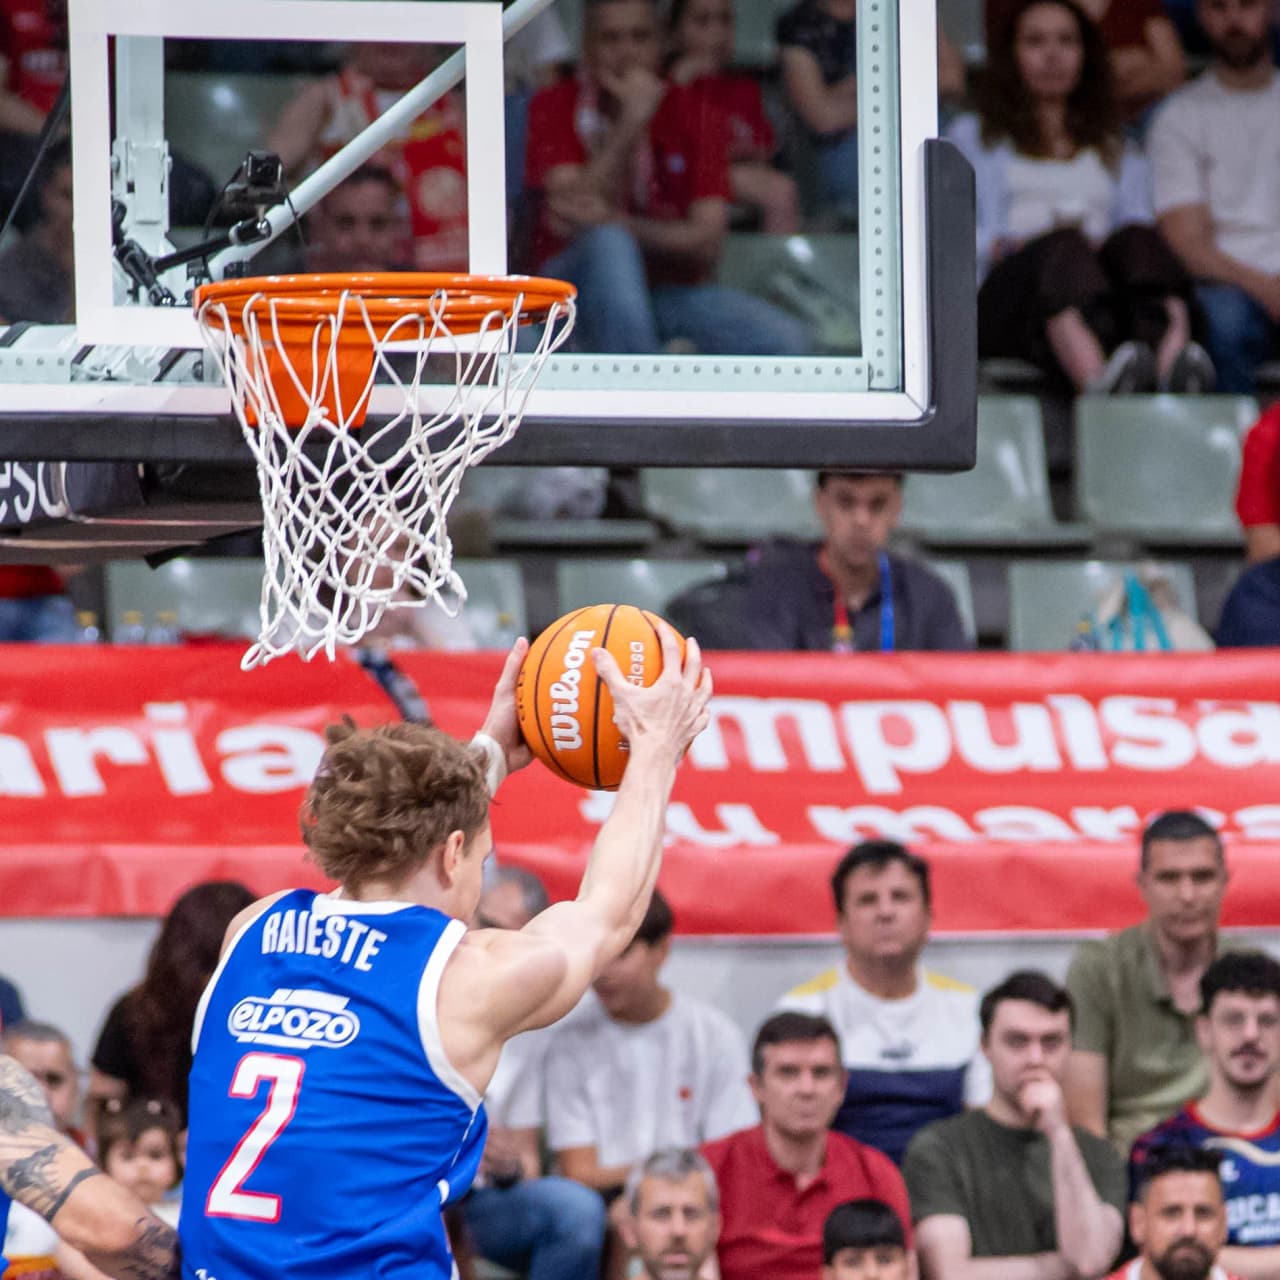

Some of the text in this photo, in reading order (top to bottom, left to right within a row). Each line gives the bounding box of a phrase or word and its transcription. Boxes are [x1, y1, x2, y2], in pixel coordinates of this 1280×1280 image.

[549, 629, 597, 752] Wilson
[261, 909, 387, 972] RAIESTE
[205, 1051, 306, 1224] 2
